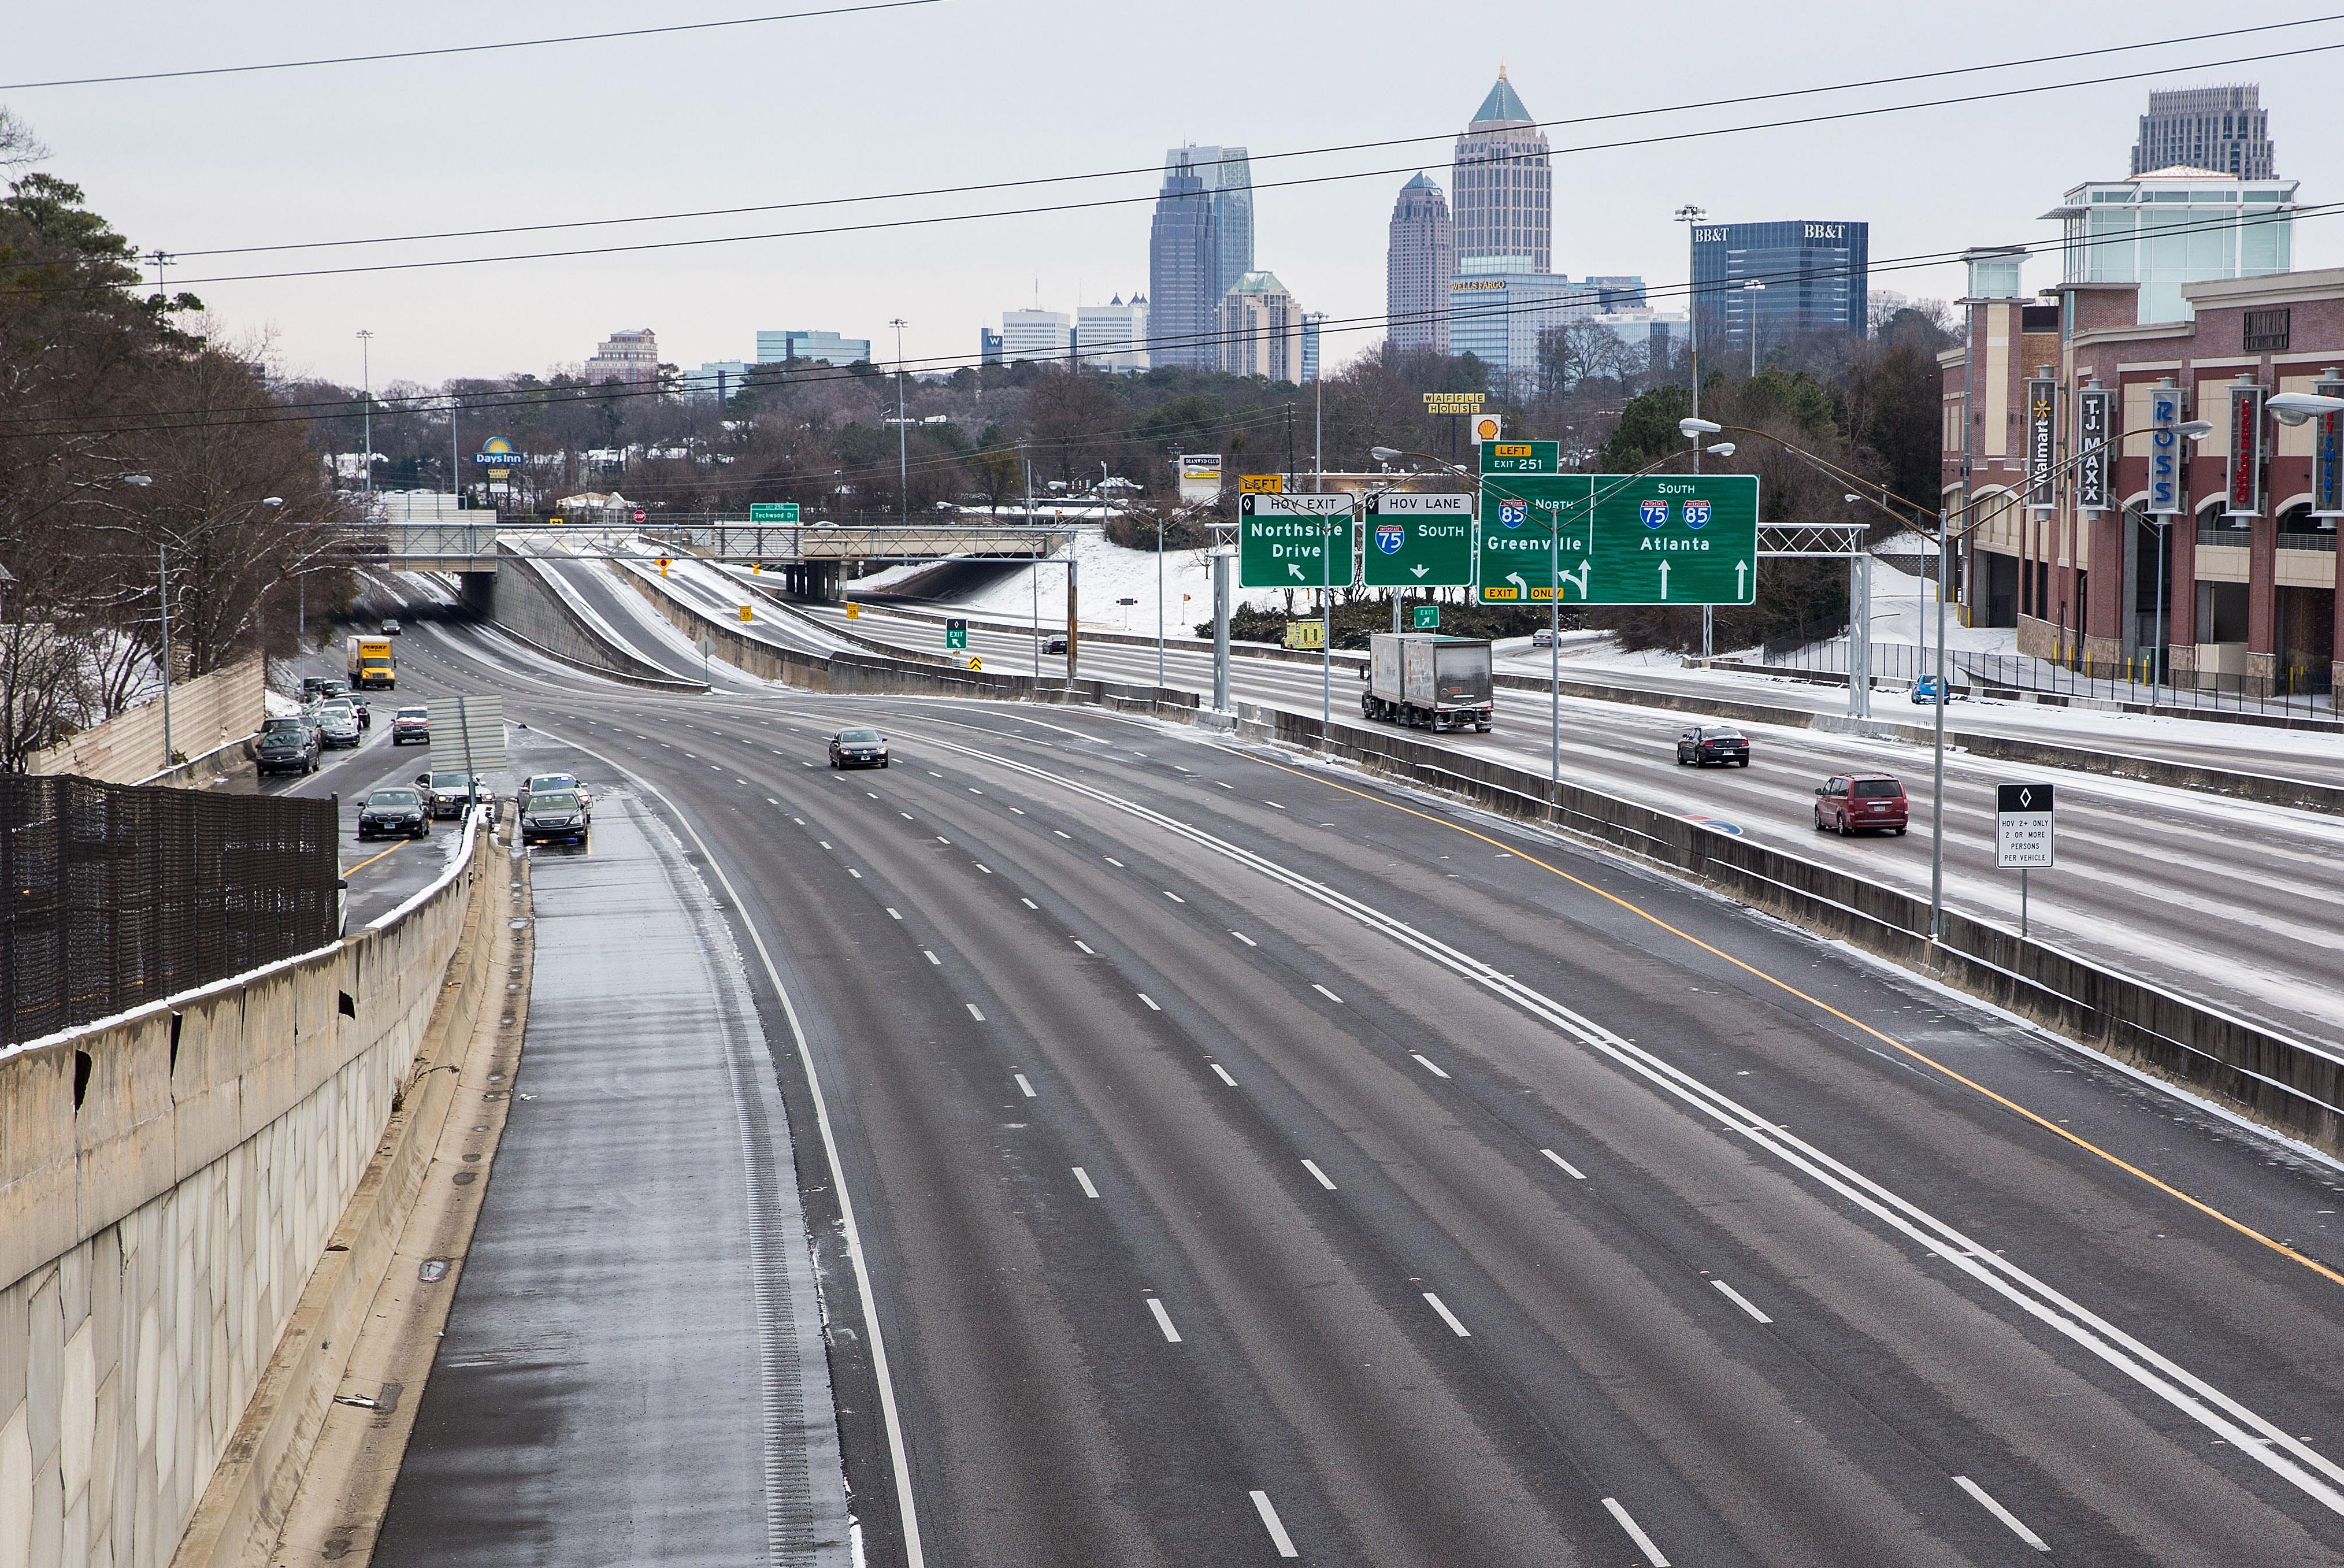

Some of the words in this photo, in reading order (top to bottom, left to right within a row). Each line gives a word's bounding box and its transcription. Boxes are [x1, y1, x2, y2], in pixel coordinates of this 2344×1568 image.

[1695, 228, 1730, 242] BB&T
[1804, 224, 1845, 239] BB&T
[1451, 282, 1478, 290] WELLS
[1479, 280, 1506, 289] FARGO
[989, 337, 1000, 345] W
[1500, 446, 1526, 455] LEFT
[2034, 420, 2049, 488] Walmart
[2154, 401, 2174, 502] ROSS
[477, 454, 502, 464] Days
[503, 454, 521, 462] Inn
[1519, 459, 1542, 469] 251
[1245, 479, 1277, 490] LEFT
[1657, 483, 1695, 494] SOUTH
[1271, 499, 1299, 509] HOV
[1307, 499, 1337, 509] EXIT
[1390, 499, 1416, 509] HOV
[1426, 498, 1461, 509] LANE
[1501, 506, 1524, 522] 85
[1536, 499, 1573, 510] NORTH
[1643, 507, 1666, 523] 75
[1685, 507, 1708, 523] 85
[1378, 532, 1401, 548] 75
[1418, 525, 1464, 538] SOUTH
[1488, 536, 1582, 550] Greenvlle
[1640, 538, 1709, 551] Atlanta
[1273, 543, 1321, 558] Drive
[1533, 590, 1562, 598] ONLY
